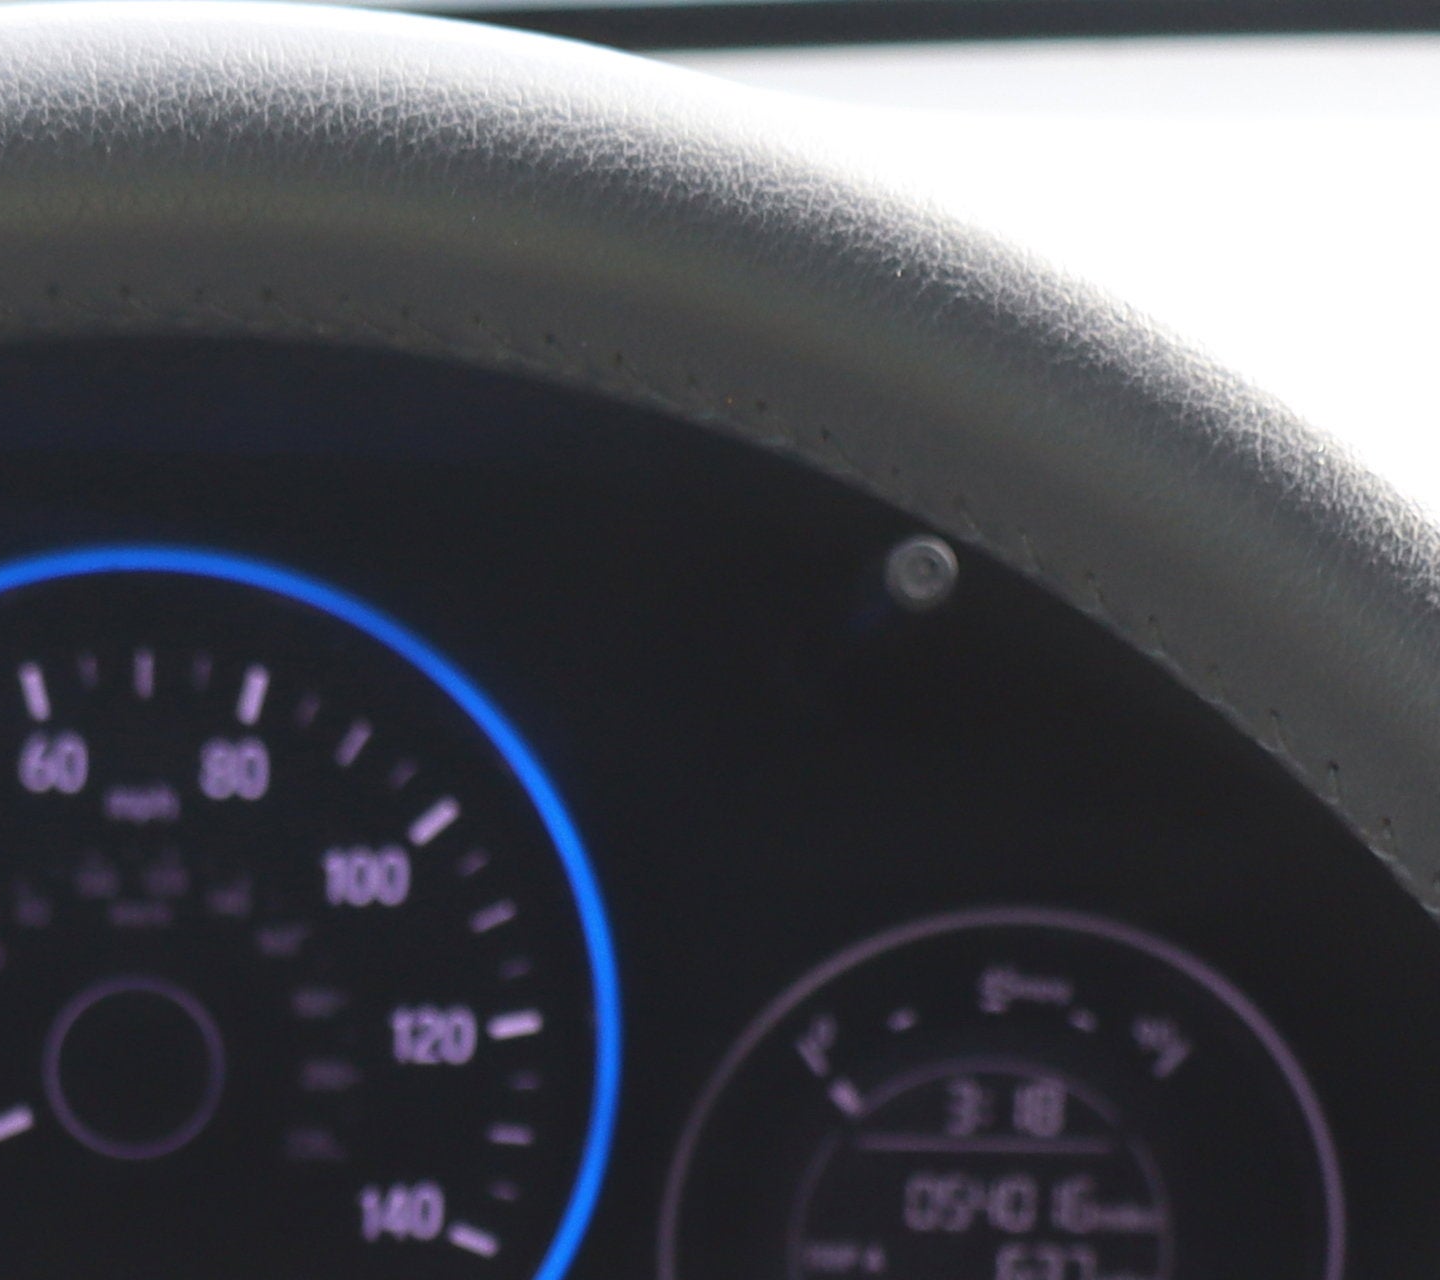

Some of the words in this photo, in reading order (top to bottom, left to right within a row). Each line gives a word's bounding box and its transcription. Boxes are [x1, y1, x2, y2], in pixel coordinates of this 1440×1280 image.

[19, 731, 90, 795] 60
[199, 736, 271, 802] 80
[323, 846, 412, 907] 100
[390, 1005, 479, 1066] 120
[358, 1182, 446, 1242] 140
